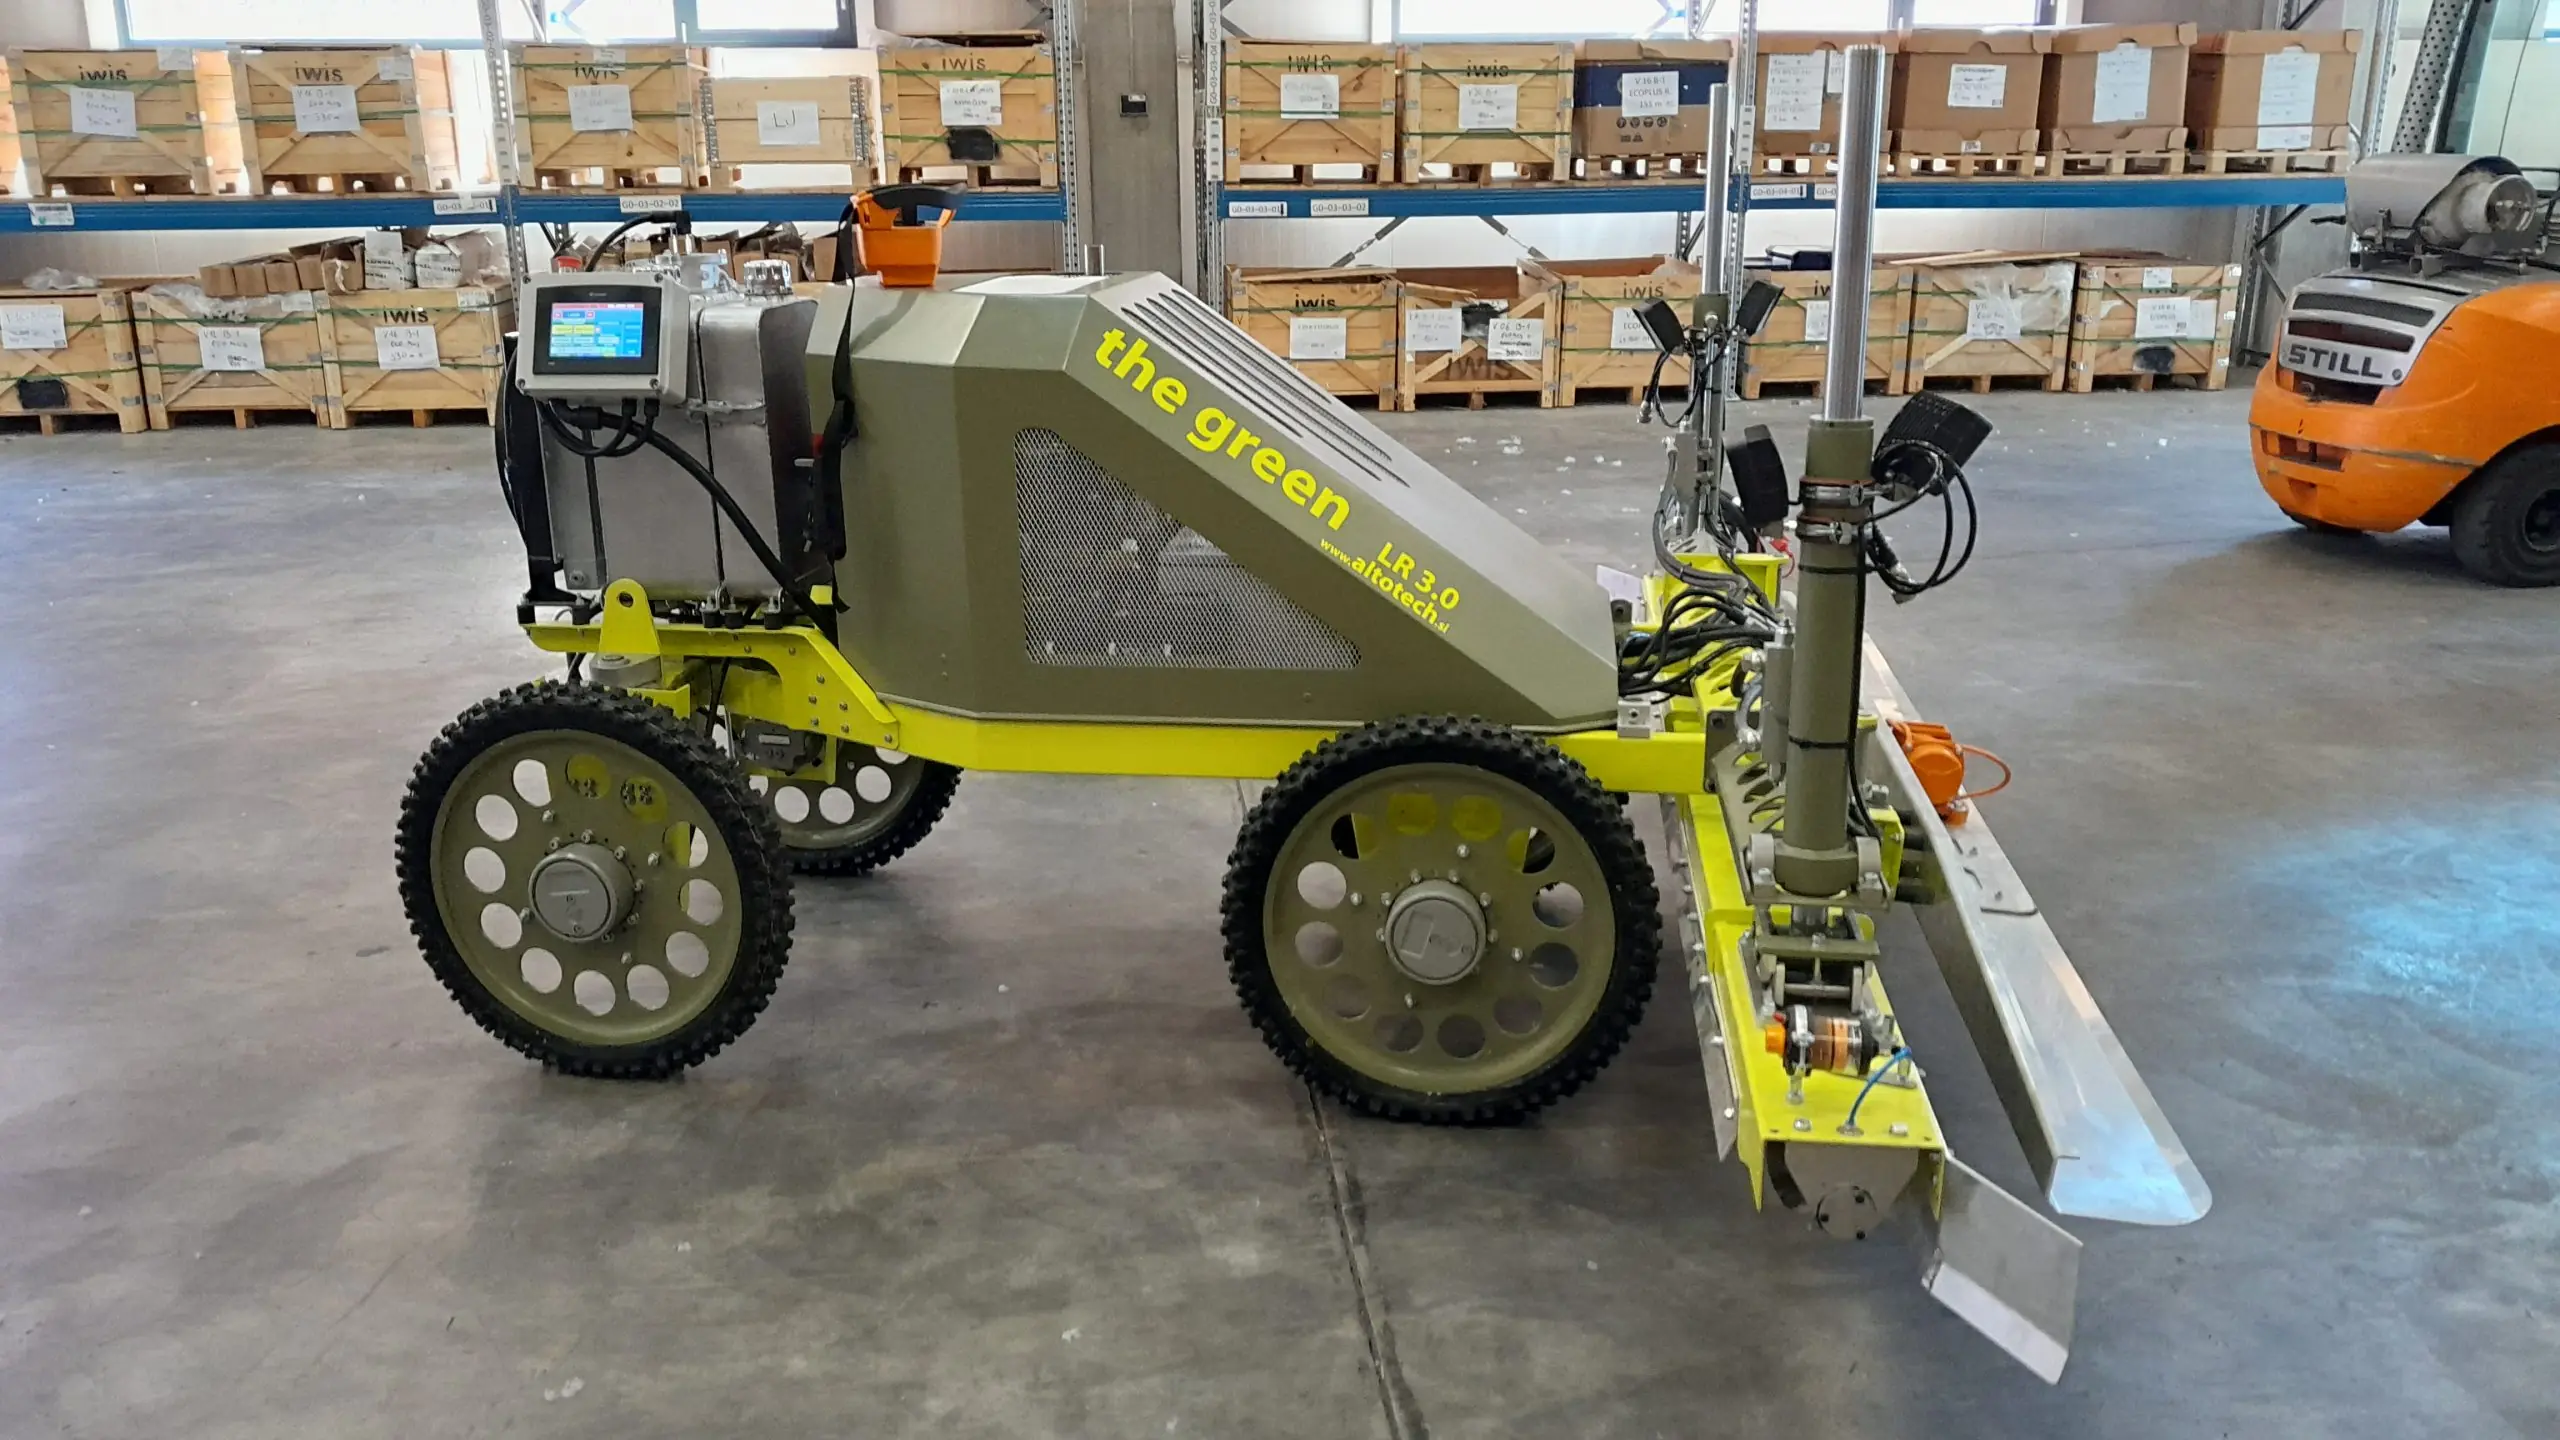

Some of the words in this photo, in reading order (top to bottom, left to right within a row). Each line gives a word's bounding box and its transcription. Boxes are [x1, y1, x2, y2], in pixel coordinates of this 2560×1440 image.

[294, 60, 344, 82] iwis
[941, 52, 987, 71] iwis
[1466, 59, 1509, 77] iwis
[78, 64, 128, 81] iwis
[1623, 280, 1664, 299] iwis
[1813, 280, 1832, 297] iw
[1295, 293, 1336, 308] iwis
[383, 304, 430, 324] iwis
[2288, 343, 2383, 379] STILL
[1095, 328, 1188, 414] the
[1186, 407, 1350, 531] green
[1377, 542, 1416, 580] LR
[1414, 569, 1461, 610] 3.0
[1320, 538, 1450, 634] www.altotech.si
